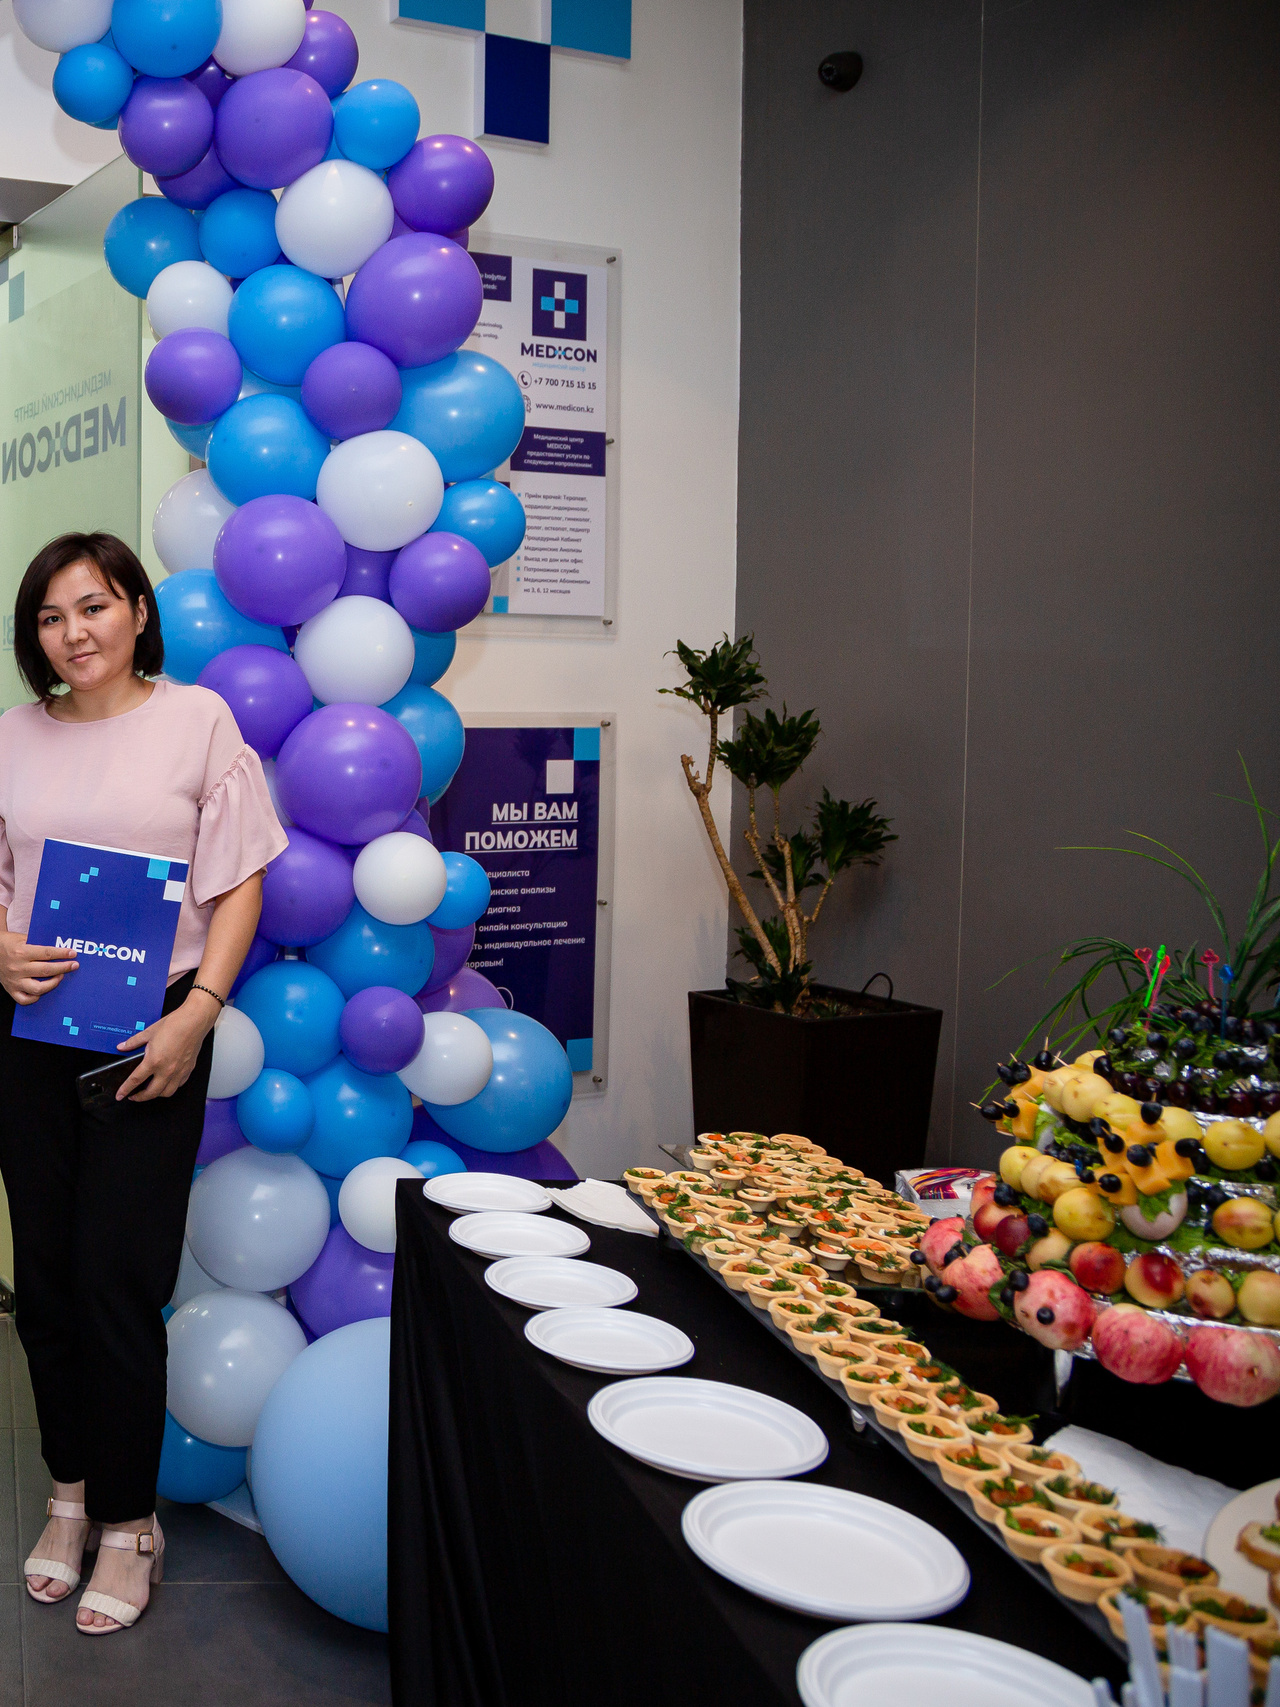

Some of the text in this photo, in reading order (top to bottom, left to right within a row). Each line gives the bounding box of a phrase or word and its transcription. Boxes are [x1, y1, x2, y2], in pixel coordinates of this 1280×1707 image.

[520, 342, 597, 363] MEDICON
[534, 377, 543, 385] +7
[561, 380, 575, 388] 715
[577, 381, 586, 389] 15
[588, 382, 597, 390] 15
[535, 402, 594, 413] www.medicon.kz
[492, 802, 578, 821] МЫ ВАМ
[465, 829, 578, 850] ПОМОЖЕМ
[486, 870, 530, 878] ециалиста
[487, 905, 521, 914] диагноз
[478, 921, 568, 931] онлайн консультацию
[484, 939, 551, 949] индивидуальное
[553, 937, 585, 945] лечение
[55, 936, 146, 964] MEDICON
[466, 958, 504, 969] доровым!
